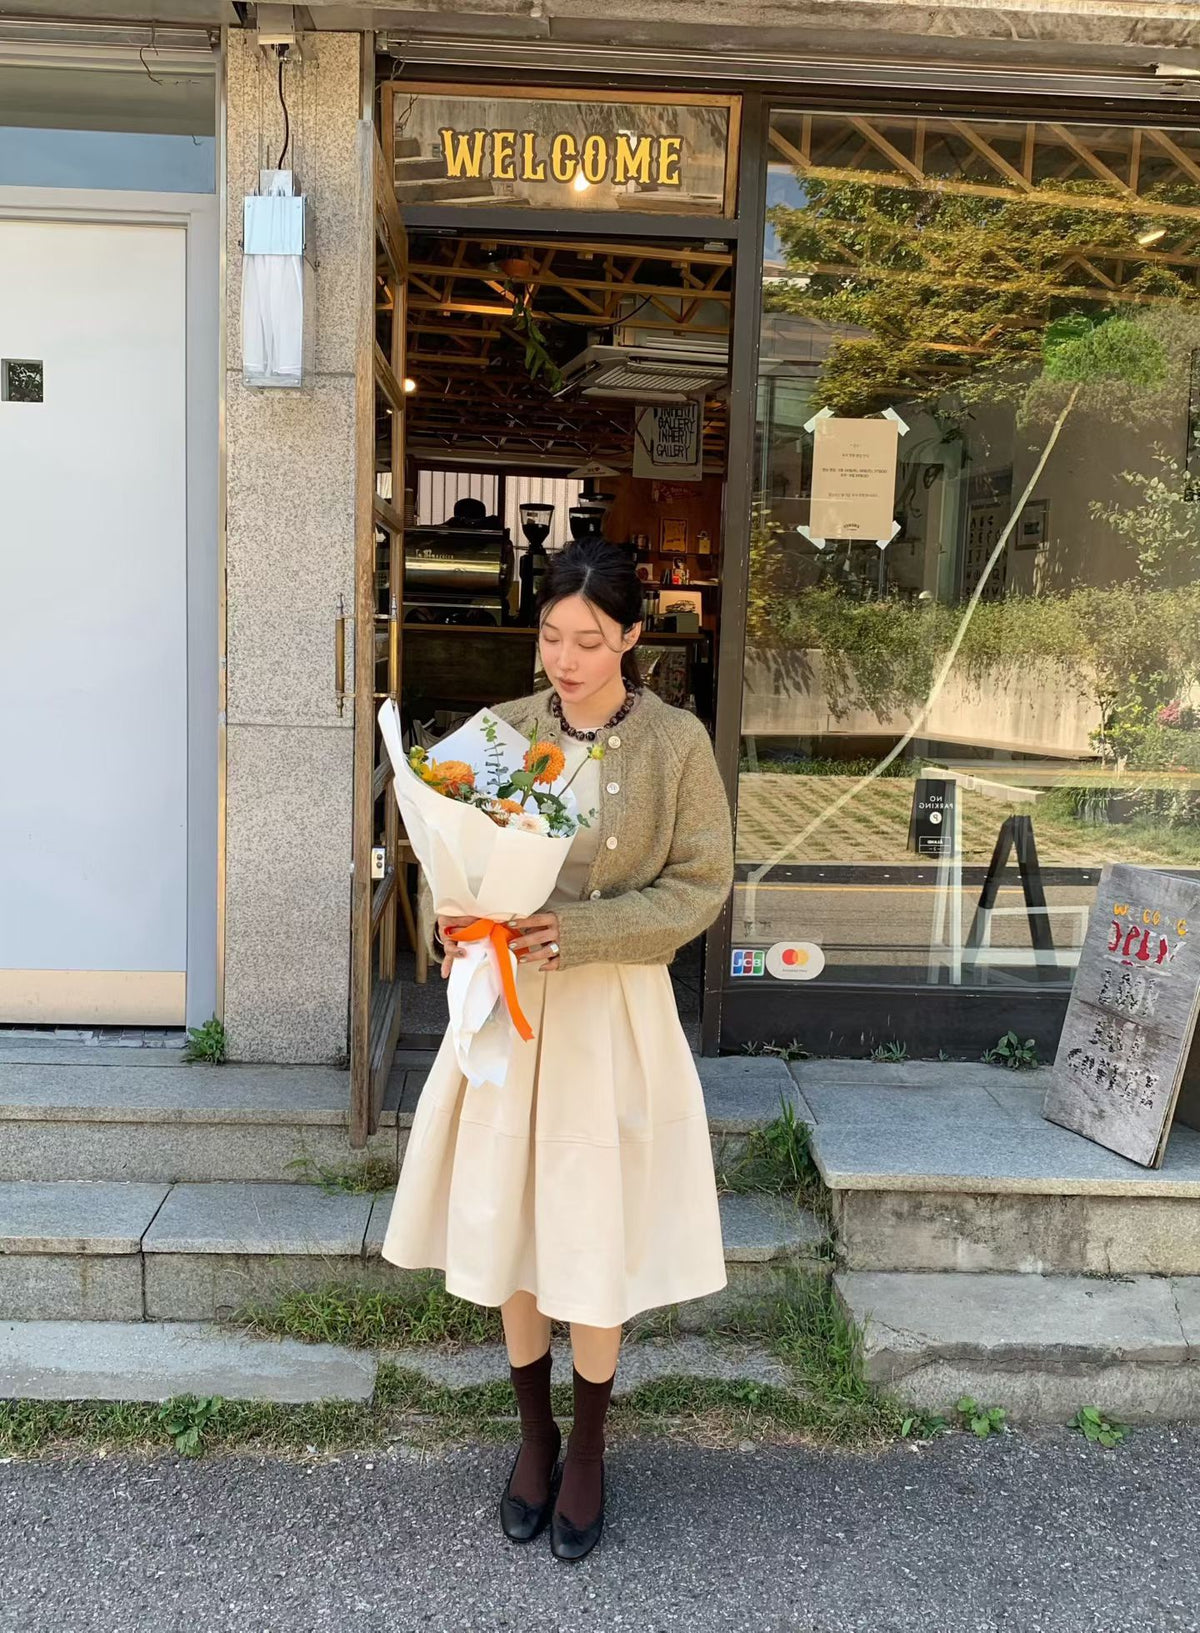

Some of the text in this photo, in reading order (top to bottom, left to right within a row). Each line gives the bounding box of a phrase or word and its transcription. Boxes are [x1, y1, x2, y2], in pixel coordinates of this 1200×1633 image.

[440, 128, 683, 186] WELCOME
[658, 417, 696, 431] GALLERY
[658, 430, 694, 445] INHERIT
[656, 444, 690, 461] GALLERY
[732, 958, 761, 967] JCB
